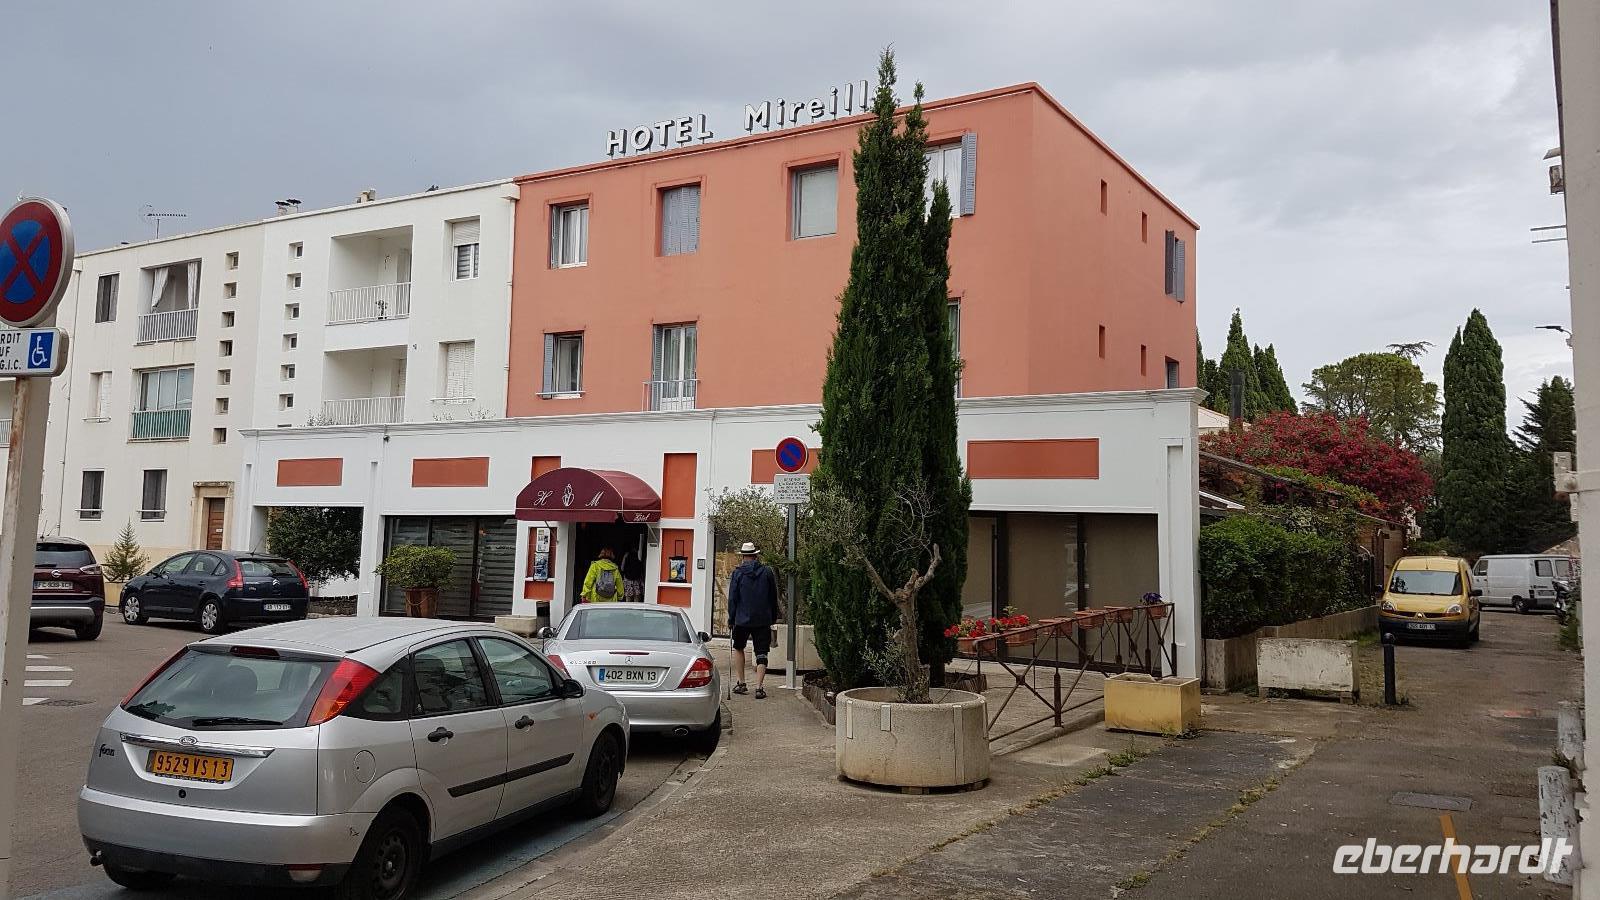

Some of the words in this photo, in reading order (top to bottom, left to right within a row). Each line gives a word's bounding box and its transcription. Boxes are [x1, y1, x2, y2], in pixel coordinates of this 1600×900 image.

[606, 114, 713, 156] HOTEL
[744, 80, 878, 132] Mireill
[533, 490, 554, 506] H
[585, 490, 605, 507] M
[605, 670, 623, 680] 402
[626, 671, 644, 681] BXN
[647, 671, 657, 681] 13
[156, 754, 190, 774] 9529
[193, 758, 207, 776] VS
[213, 760, 230, 778] 13
